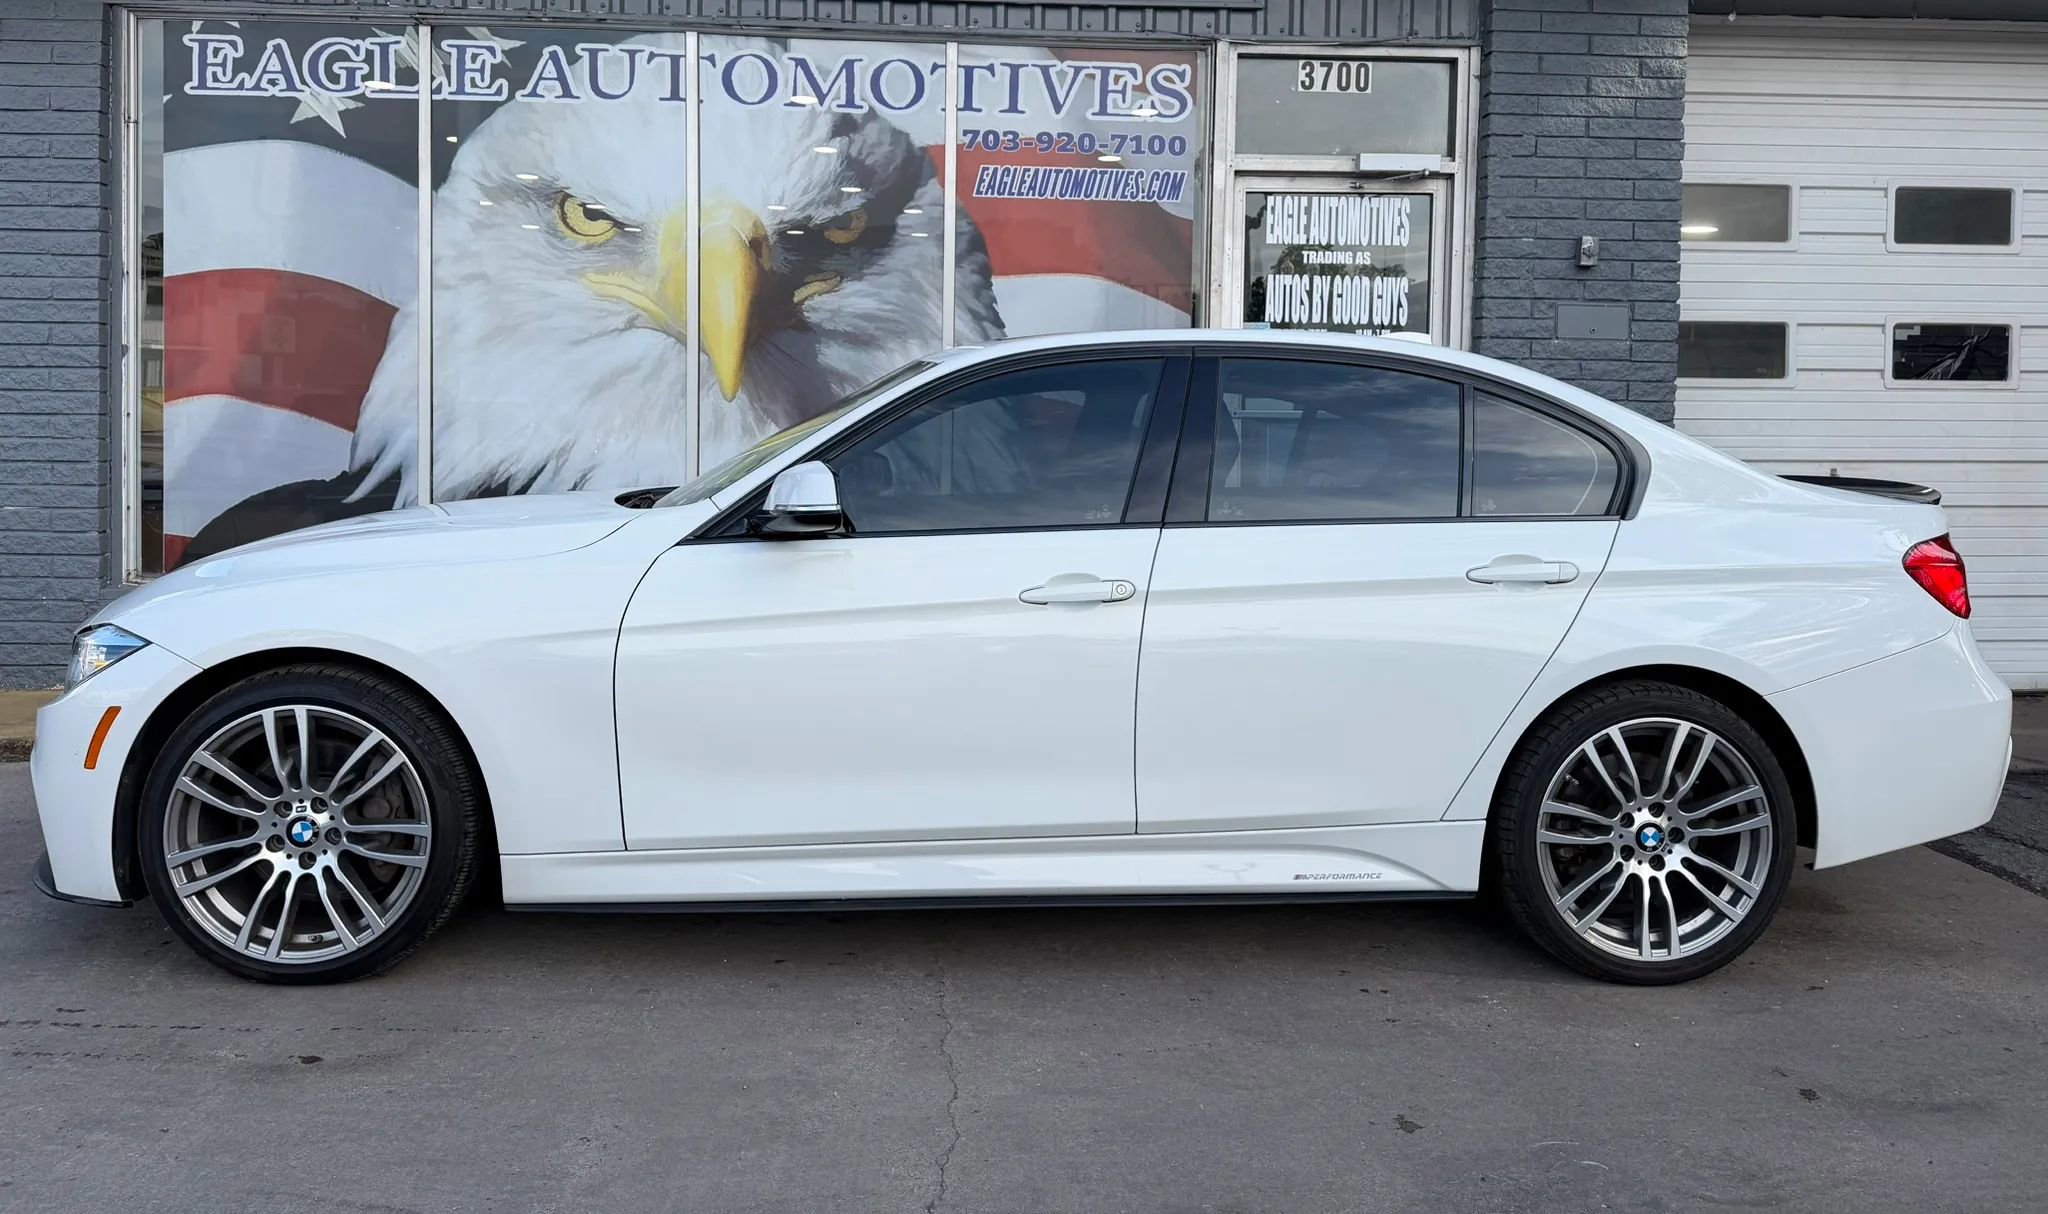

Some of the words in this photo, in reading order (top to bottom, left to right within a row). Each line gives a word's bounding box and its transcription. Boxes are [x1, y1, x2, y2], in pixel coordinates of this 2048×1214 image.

[184, 34, 509, 101] EAGLE
[515, 45, 1195, 122] AUTOMOTIVES
[1300, 60, 1370, 92] 3700
[962, 128, 1188, 156] 703-920-7100
[973, 164, 1188, 203] EAGLEAUTOMOTIVES.COM
[1266, 195, 1308, 245] EAGLE
[1310, 196, 1411, 247] AUTOMOTIVES
[1301, 250, 1353, 265] TRADING
[1355, 252, 1371, 265] AS
[1265, 274, 1310, 324] AUTOS
[1312, 275, 1331, 324] BY
[1332, 275, 1371, 326] GOOD
[1373, 275, 1409, 328] GUYS
